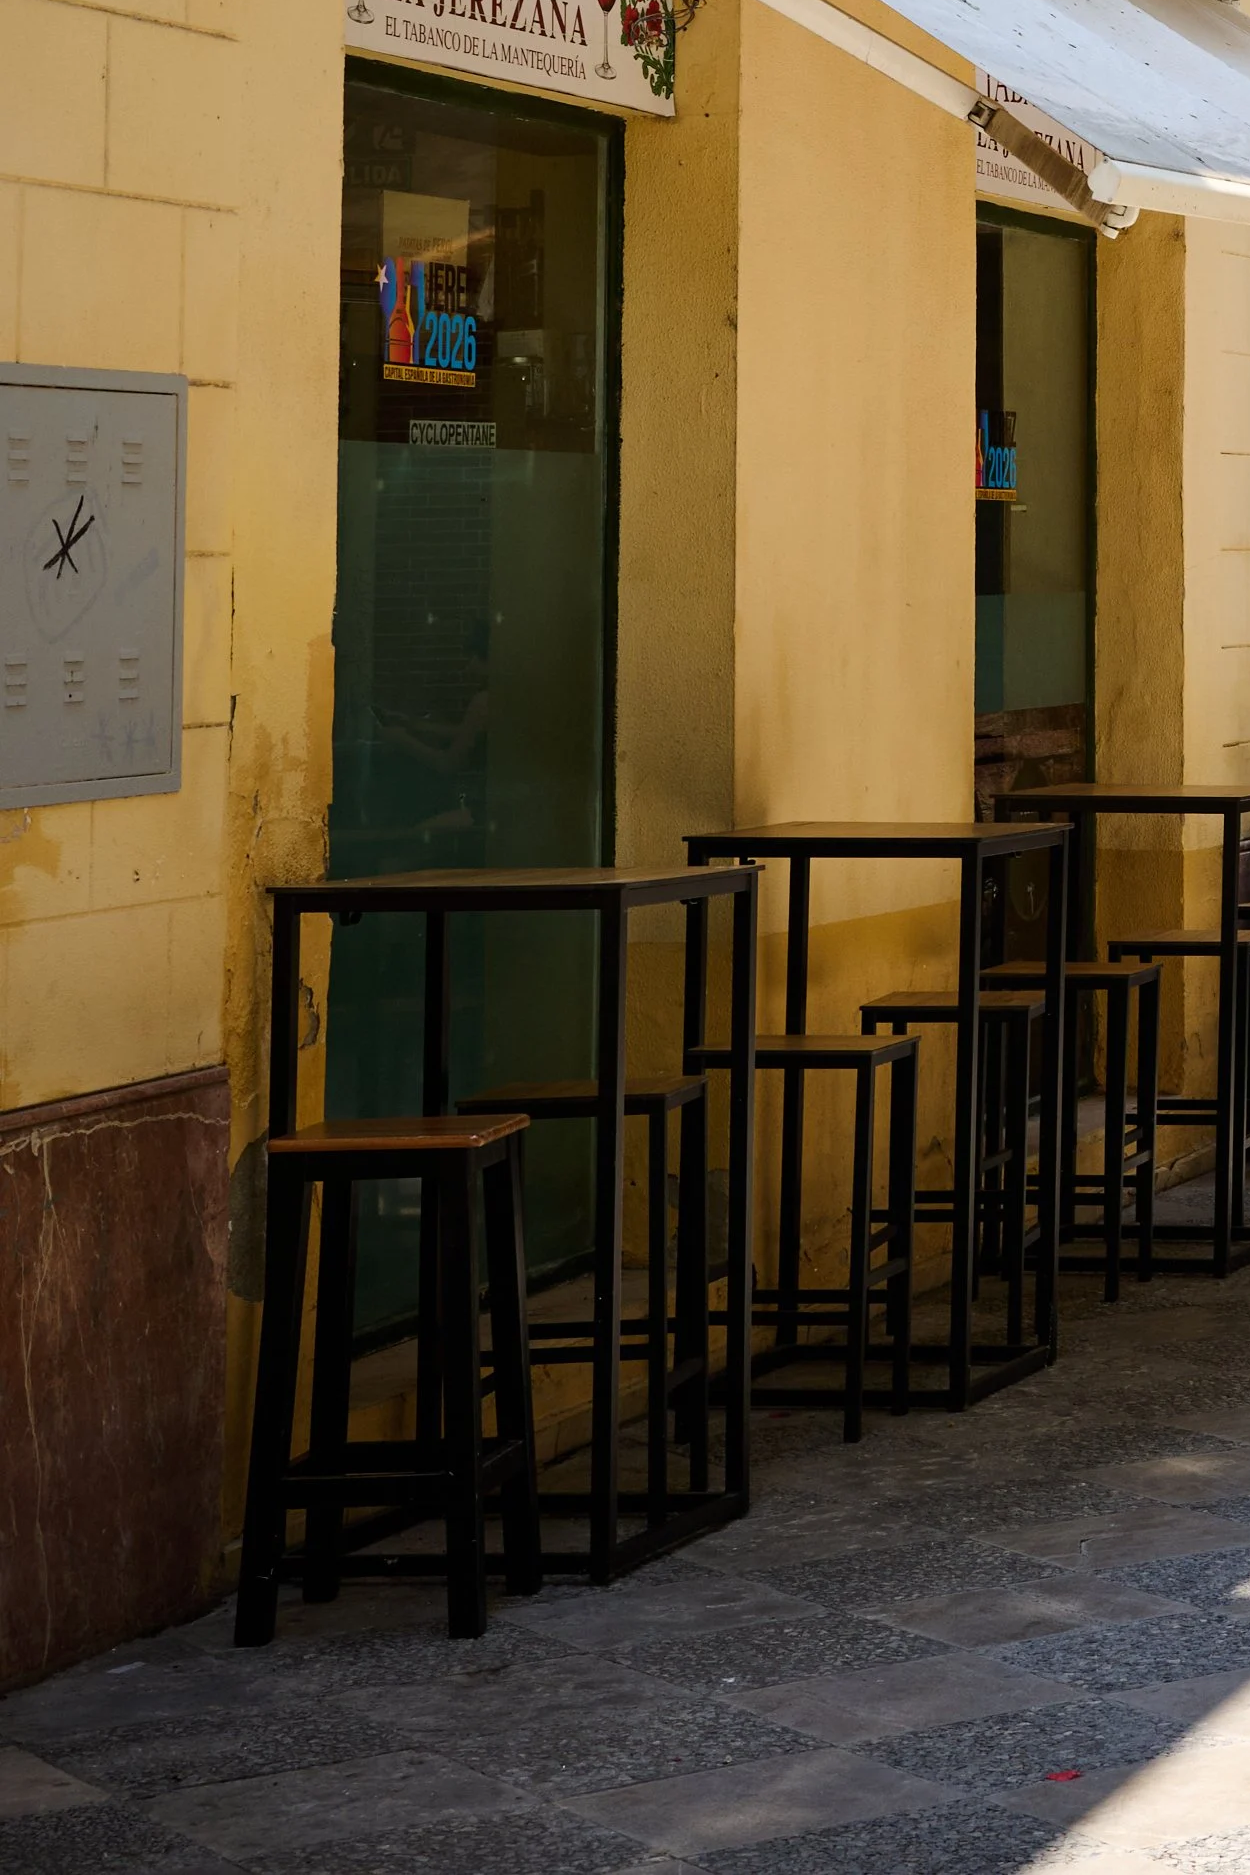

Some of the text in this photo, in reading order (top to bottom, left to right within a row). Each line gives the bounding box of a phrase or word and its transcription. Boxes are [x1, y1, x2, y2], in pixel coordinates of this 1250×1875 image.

[385, 15, 586, 80] EL TABANCO DE LA MANTEQUERÍA
[976, 158, 985, 175] EL
[986, 161, 1018, 183] TABANCO
[424, 312, 477, 372] 2026
[410, 423, 495, 446] CYCLOPENTANE
[988, 447, 1017, 488] 2026
